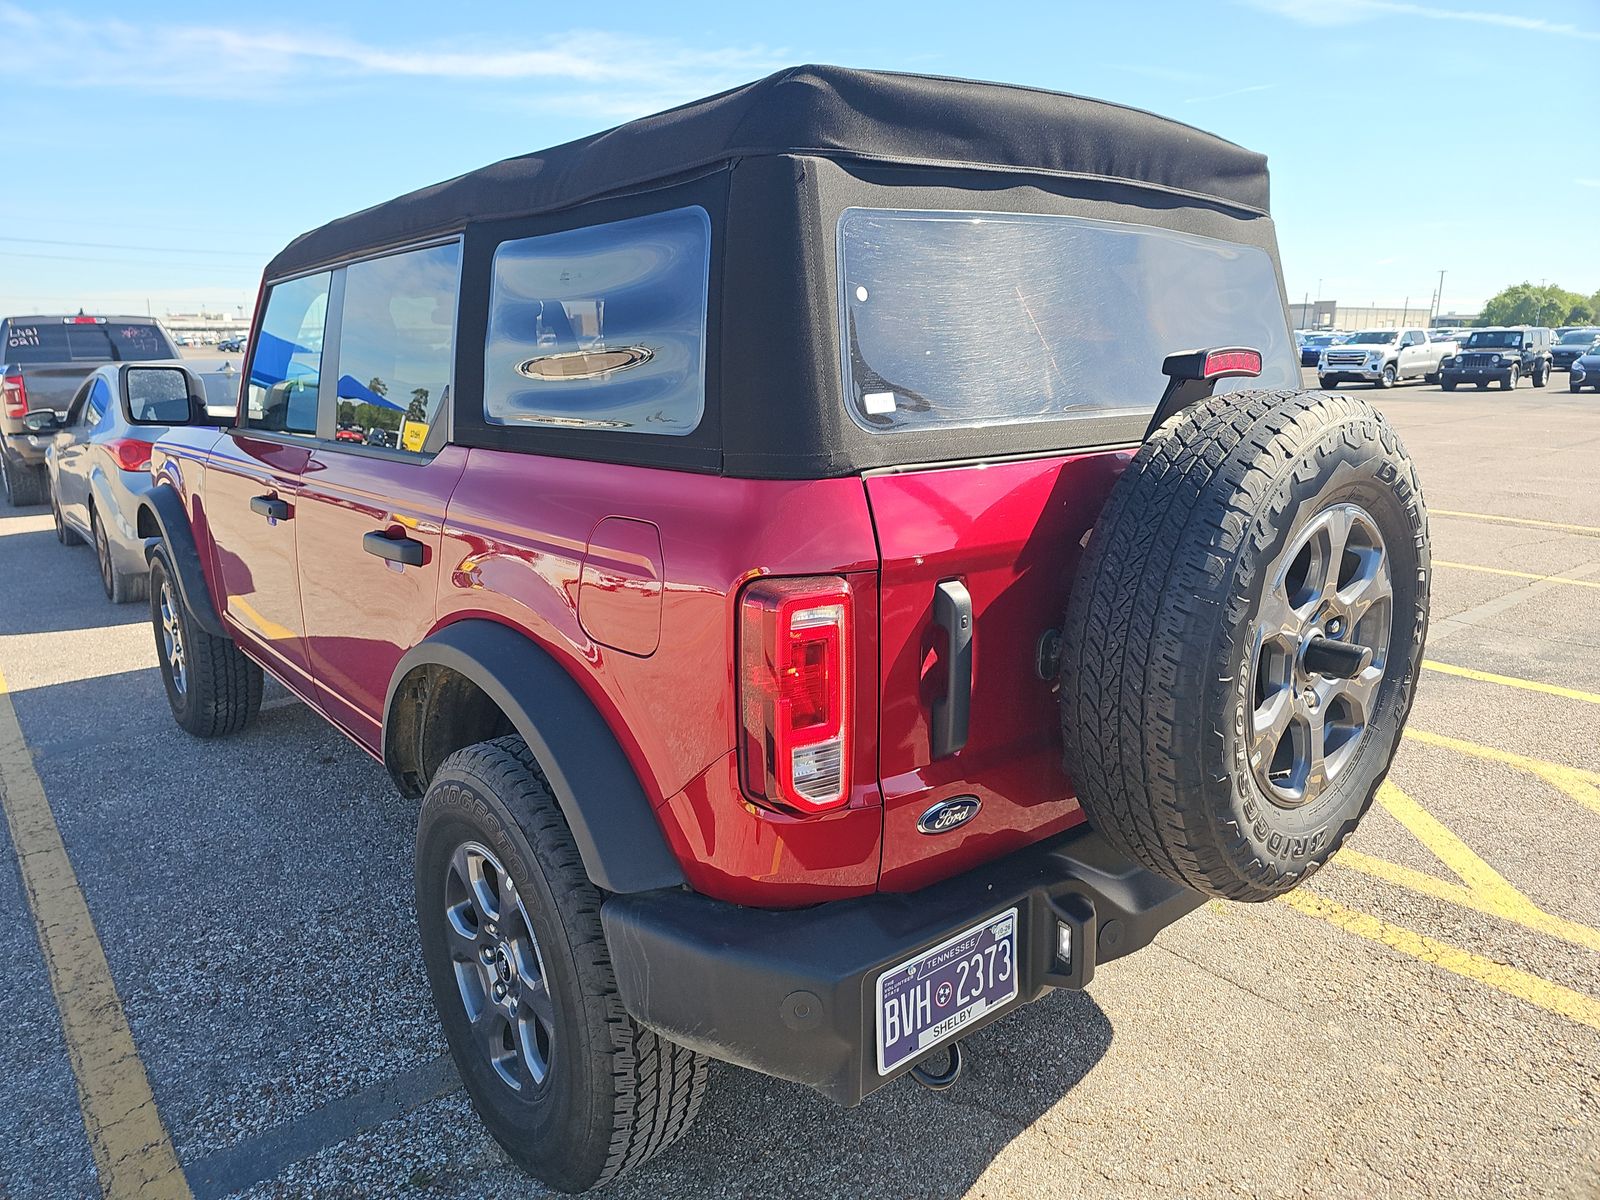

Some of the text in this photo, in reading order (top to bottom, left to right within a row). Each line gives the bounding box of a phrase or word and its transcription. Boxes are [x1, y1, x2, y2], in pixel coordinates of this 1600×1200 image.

[1374, 457, 1428, 647] DUELER
[1233, 619, 1329, 863] BRIDGESTONE
[934, 804, 970, 829] Ford
[926, 937, 976, 969] TENNESSEE
[884, 939, 1011, 1048] BVH 2373
[933, 1007, 973, 1038] SHELBY
